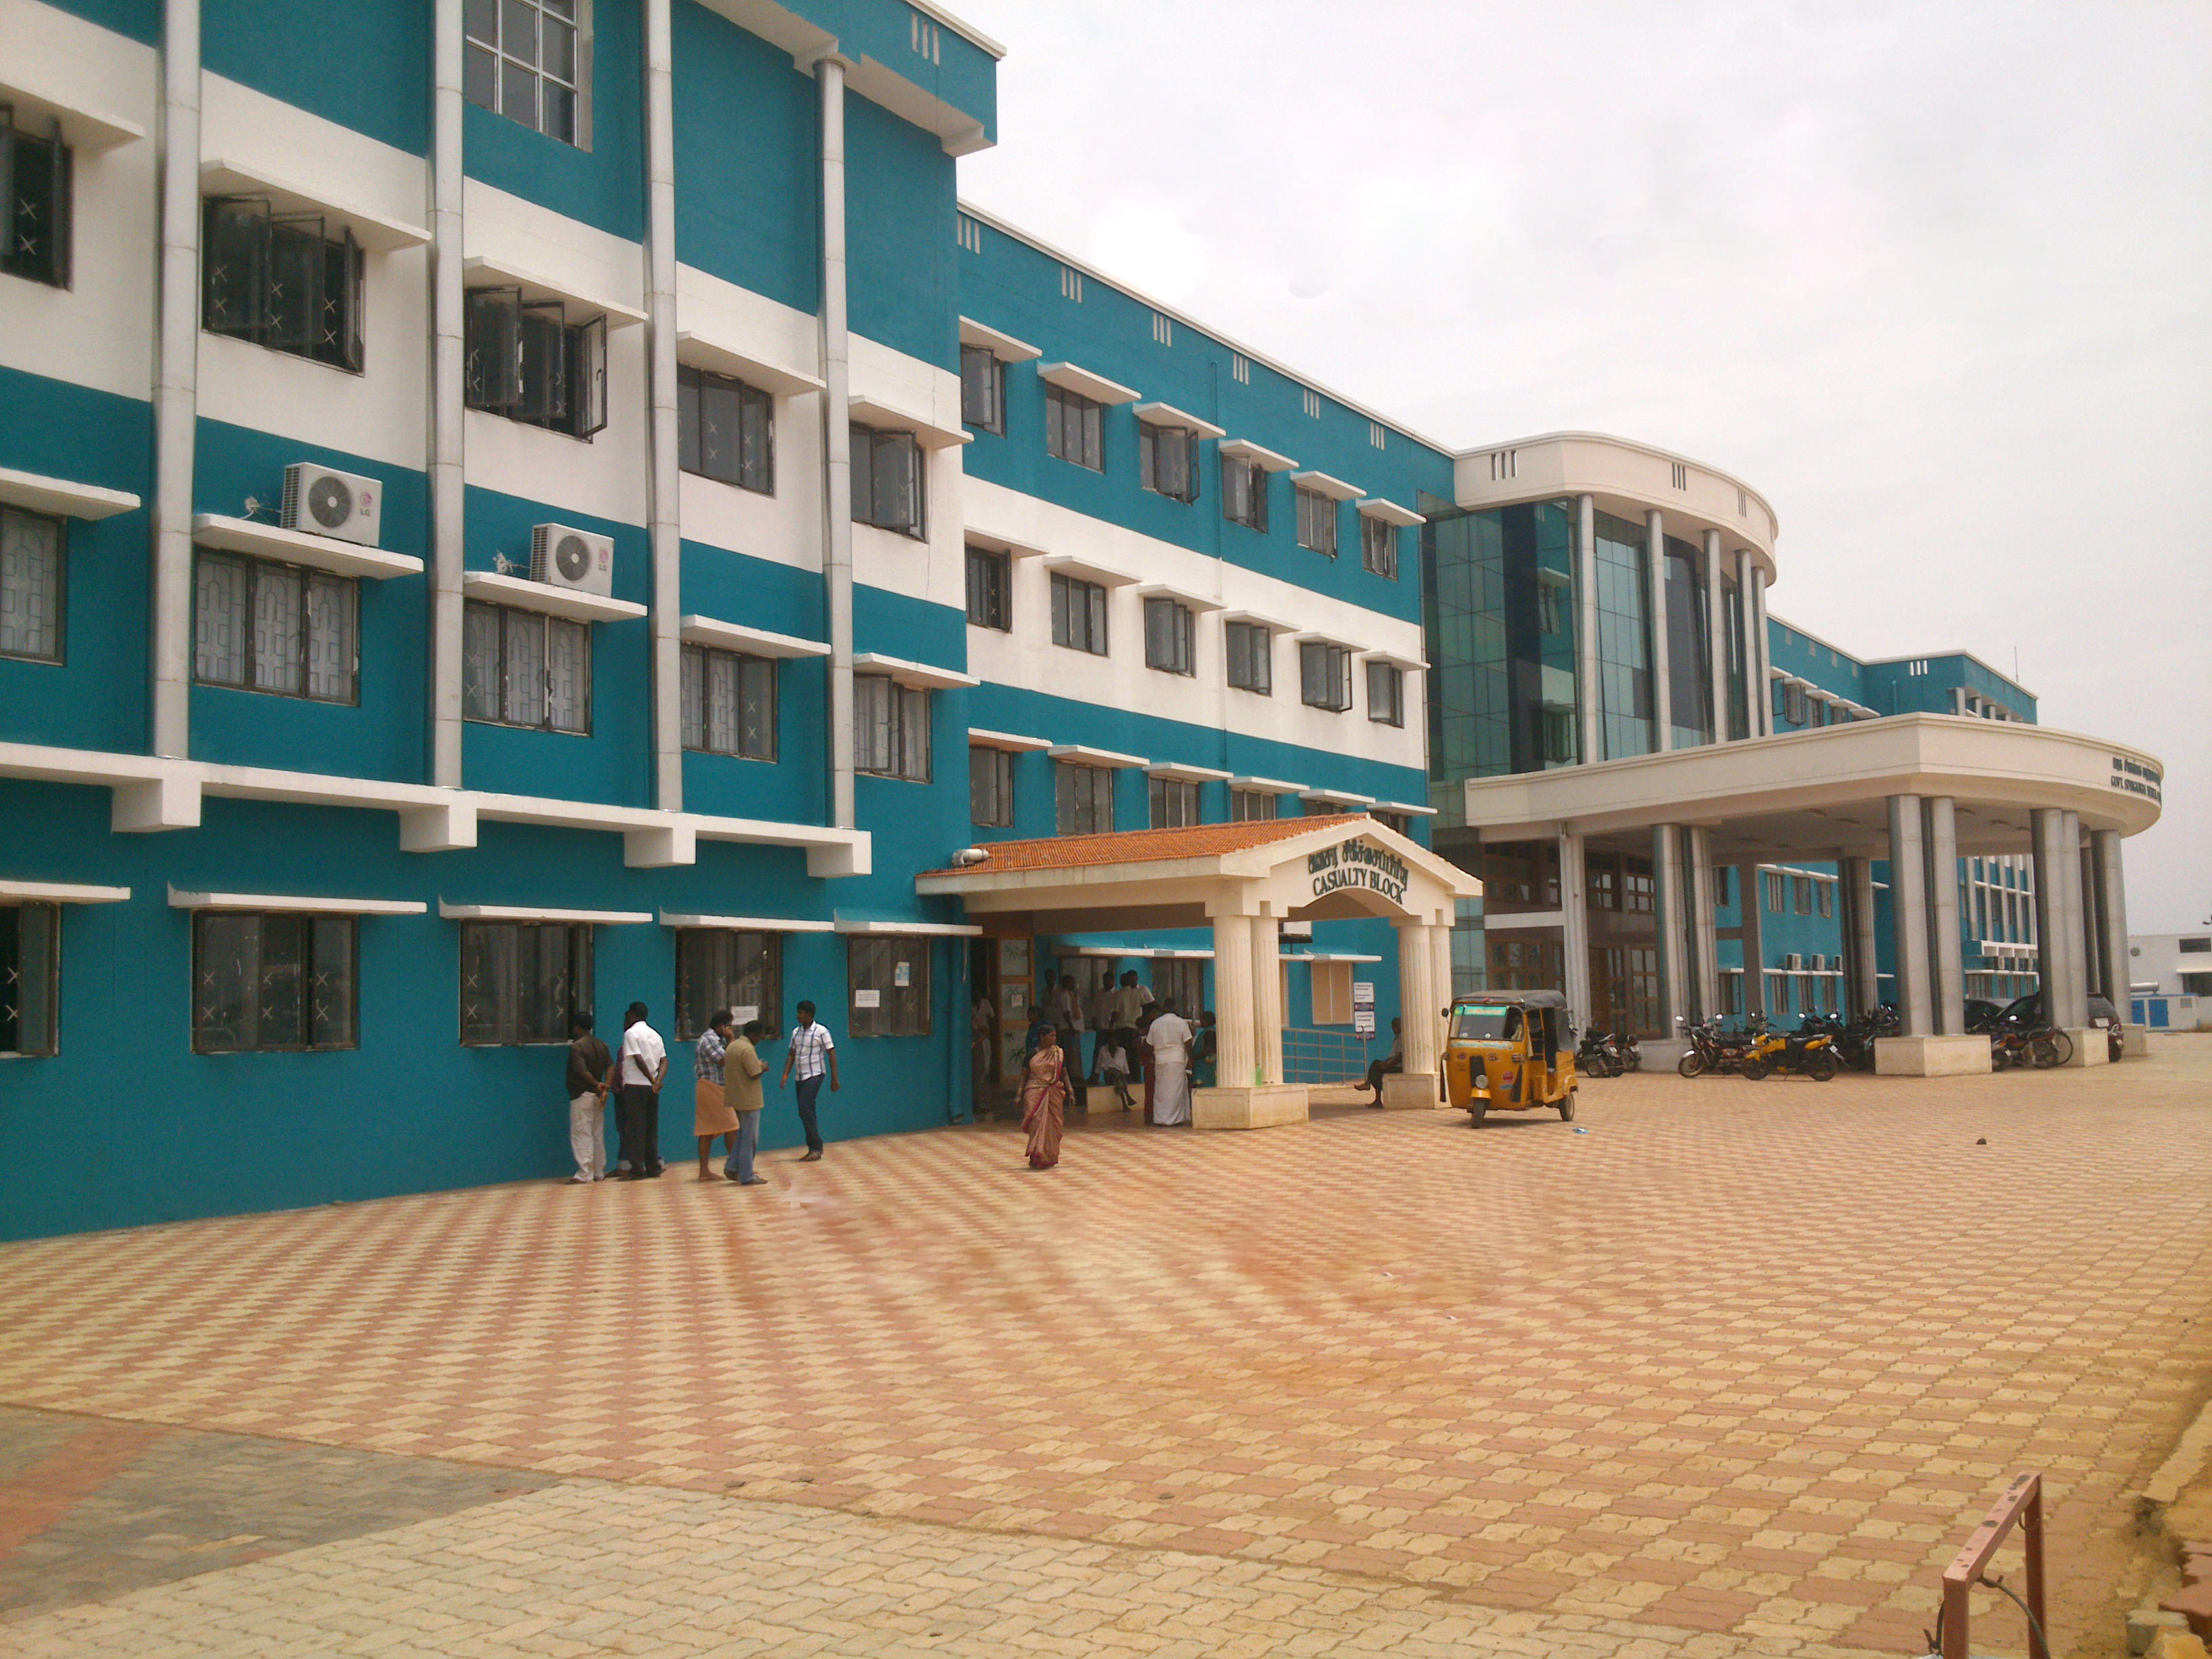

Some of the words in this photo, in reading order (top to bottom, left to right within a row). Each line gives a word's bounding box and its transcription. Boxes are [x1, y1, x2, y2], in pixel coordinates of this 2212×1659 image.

[360, 508, 370, 516] LG
[598, 563, 607, 572] LG
[1313, 867, 1368, 896] CASUALTY
[1370, 870, 1404, 905] BLOCK
